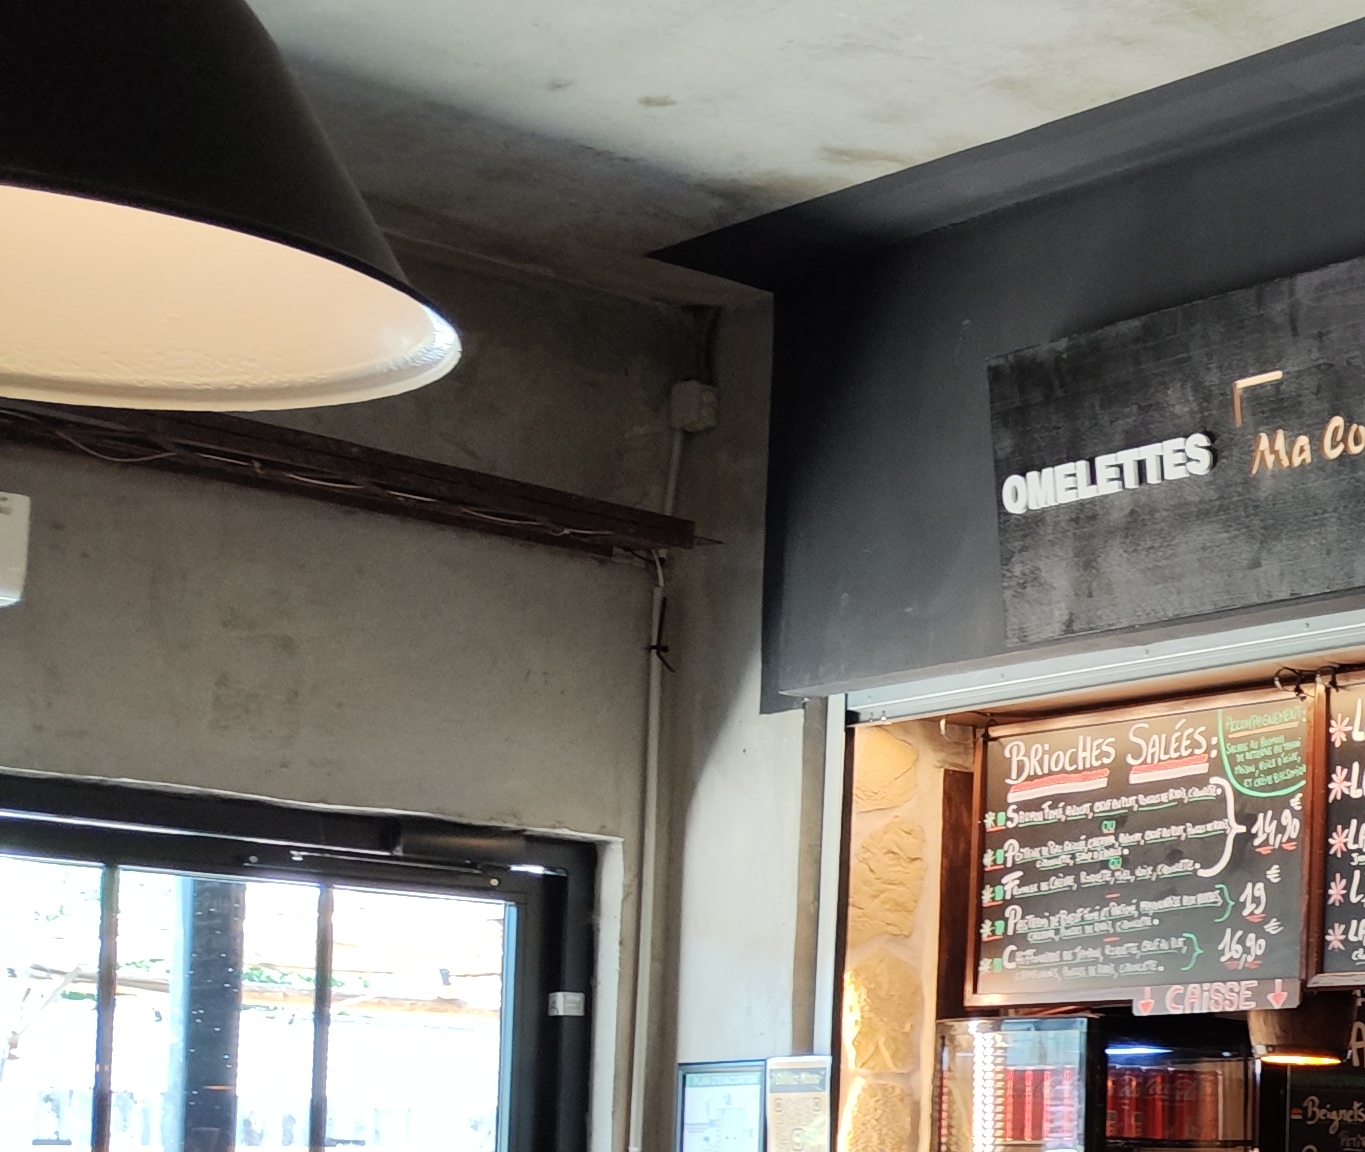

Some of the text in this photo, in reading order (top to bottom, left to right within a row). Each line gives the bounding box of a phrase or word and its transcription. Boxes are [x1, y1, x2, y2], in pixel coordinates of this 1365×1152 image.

[1001, 431, 1214, 515] OMELETTES
[1249, 427, 1313, 477] Ma
[1166, 980, 1258, 1004] CAISSE
